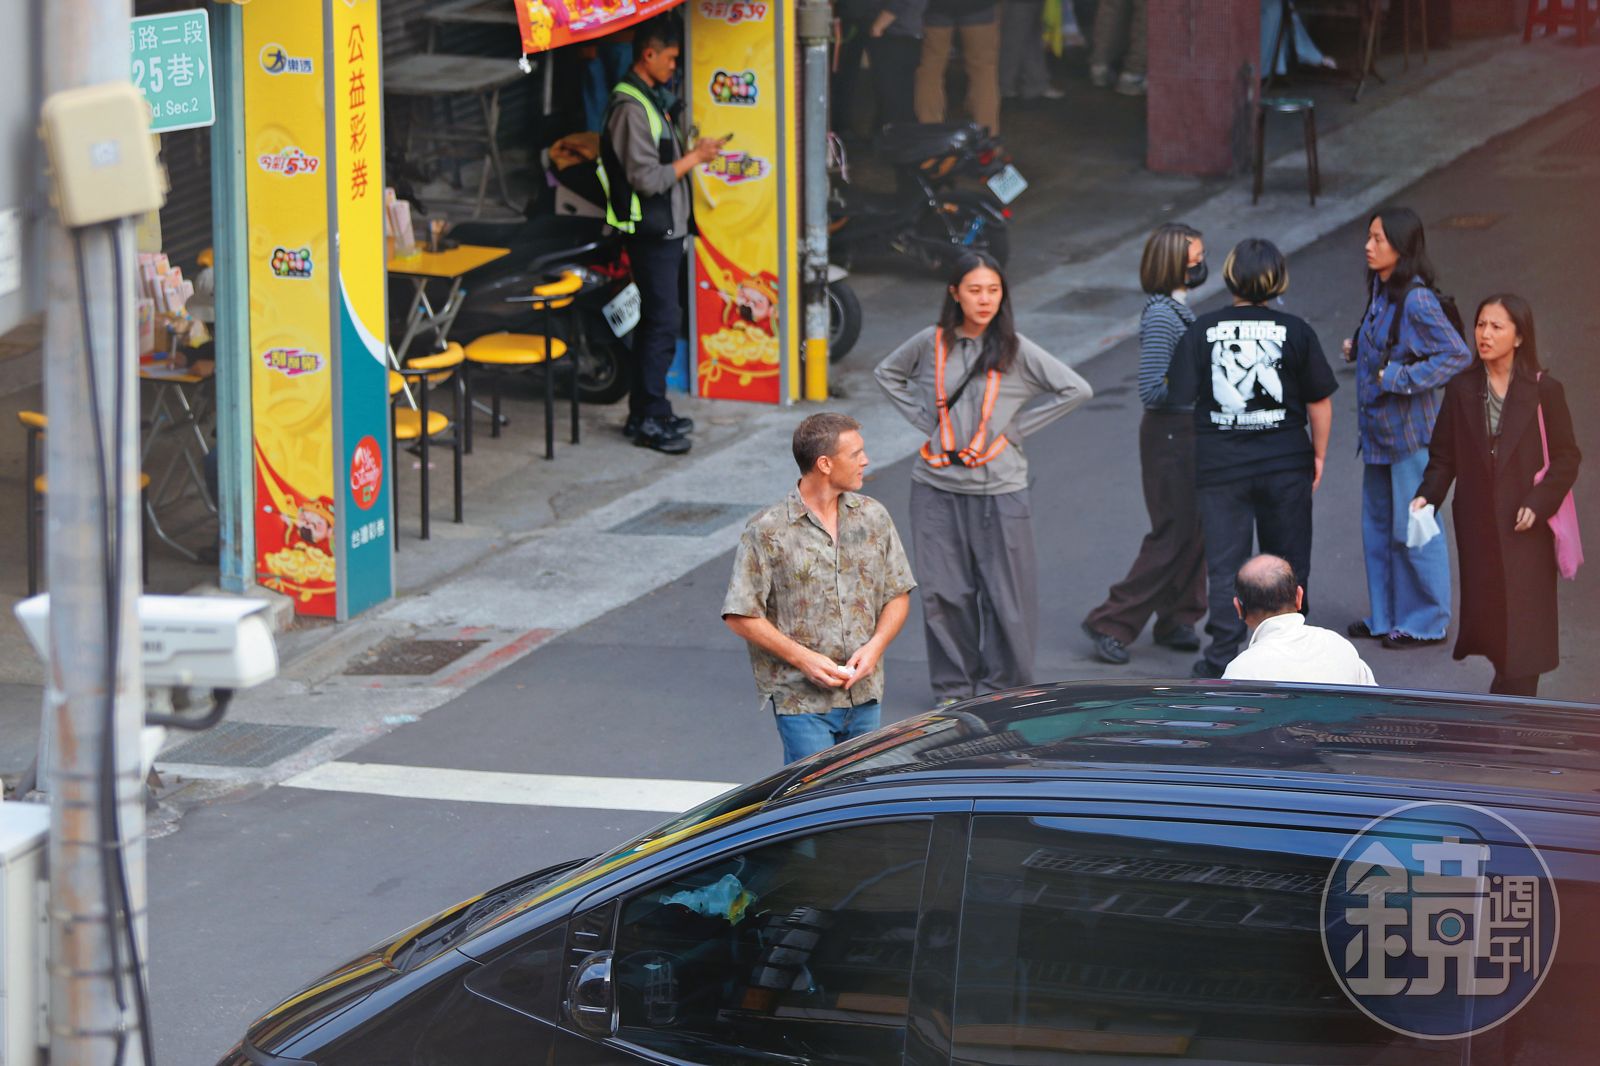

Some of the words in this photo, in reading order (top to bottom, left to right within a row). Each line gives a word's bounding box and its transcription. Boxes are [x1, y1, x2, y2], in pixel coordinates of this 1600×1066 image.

[166, 97, 199, 116] Sec.2
[348, 23, 368, 201] 公益彩券
